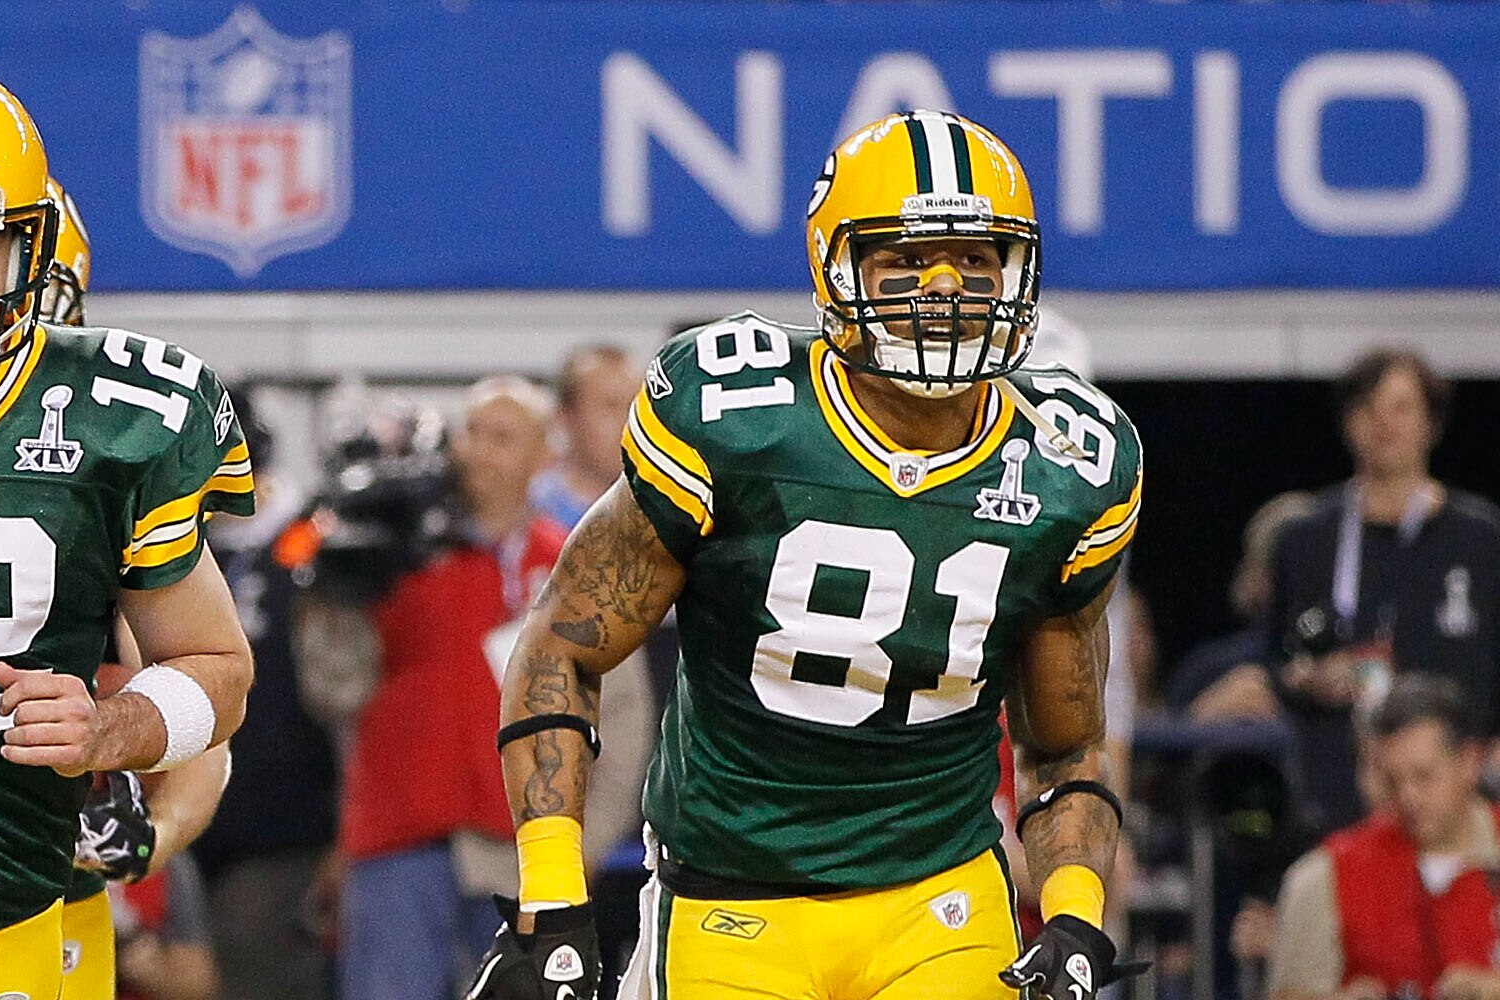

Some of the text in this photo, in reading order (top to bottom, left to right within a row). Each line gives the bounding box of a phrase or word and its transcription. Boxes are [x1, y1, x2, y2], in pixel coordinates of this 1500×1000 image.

[172, 126, 328, 229] NFL
[925, 199, 968, 208] Riddell
[90, 328, 204, 434] 12
[696, 317, 795, 423] 81
[13, 445, 84, 474] XLV
[972, 493, 1042, 526] XLV
[749, 518, 1011, 729] 81
